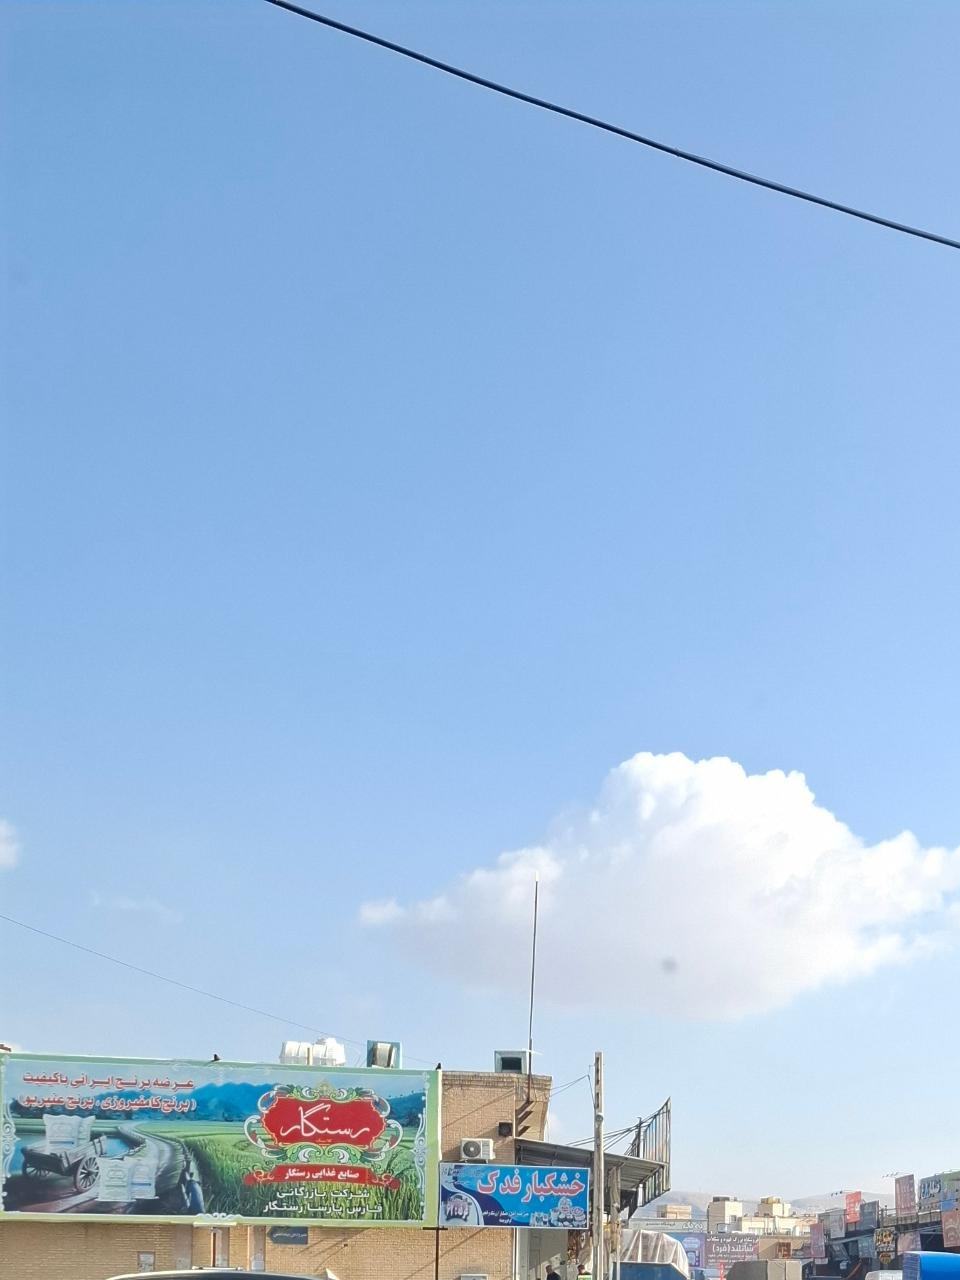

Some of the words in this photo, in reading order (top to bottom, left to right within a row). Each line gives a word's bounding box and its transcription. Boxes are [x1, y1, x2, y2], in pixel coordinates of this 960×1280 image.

[71, 1074, 114, 1089] ایرانی
[115, 1077, 151, 1092] برنج
[153, 1076, 195, 1093] عرضه
[66, 1094, 95, 1109] برنج
[279, 1102, 370, 1139] رستگار
[285, 1168, 311, 1180] رستگار
[312, 1168, 337, 1180] غذایی
[338, 1169, 360, 1180] صنایع
[477, 1168, 522, 1194] فدک
[521, 1170, 586, 1203] خشکبار
[276, 1187, 326, 1199] بازرگانی
[331, 1188, 370, 1199] شرکت
[263, 1201, 304, 1213] رستگار
[307, 1202, 343, 1214] پارسا
[347, 1203, 383, 1214] فارس
